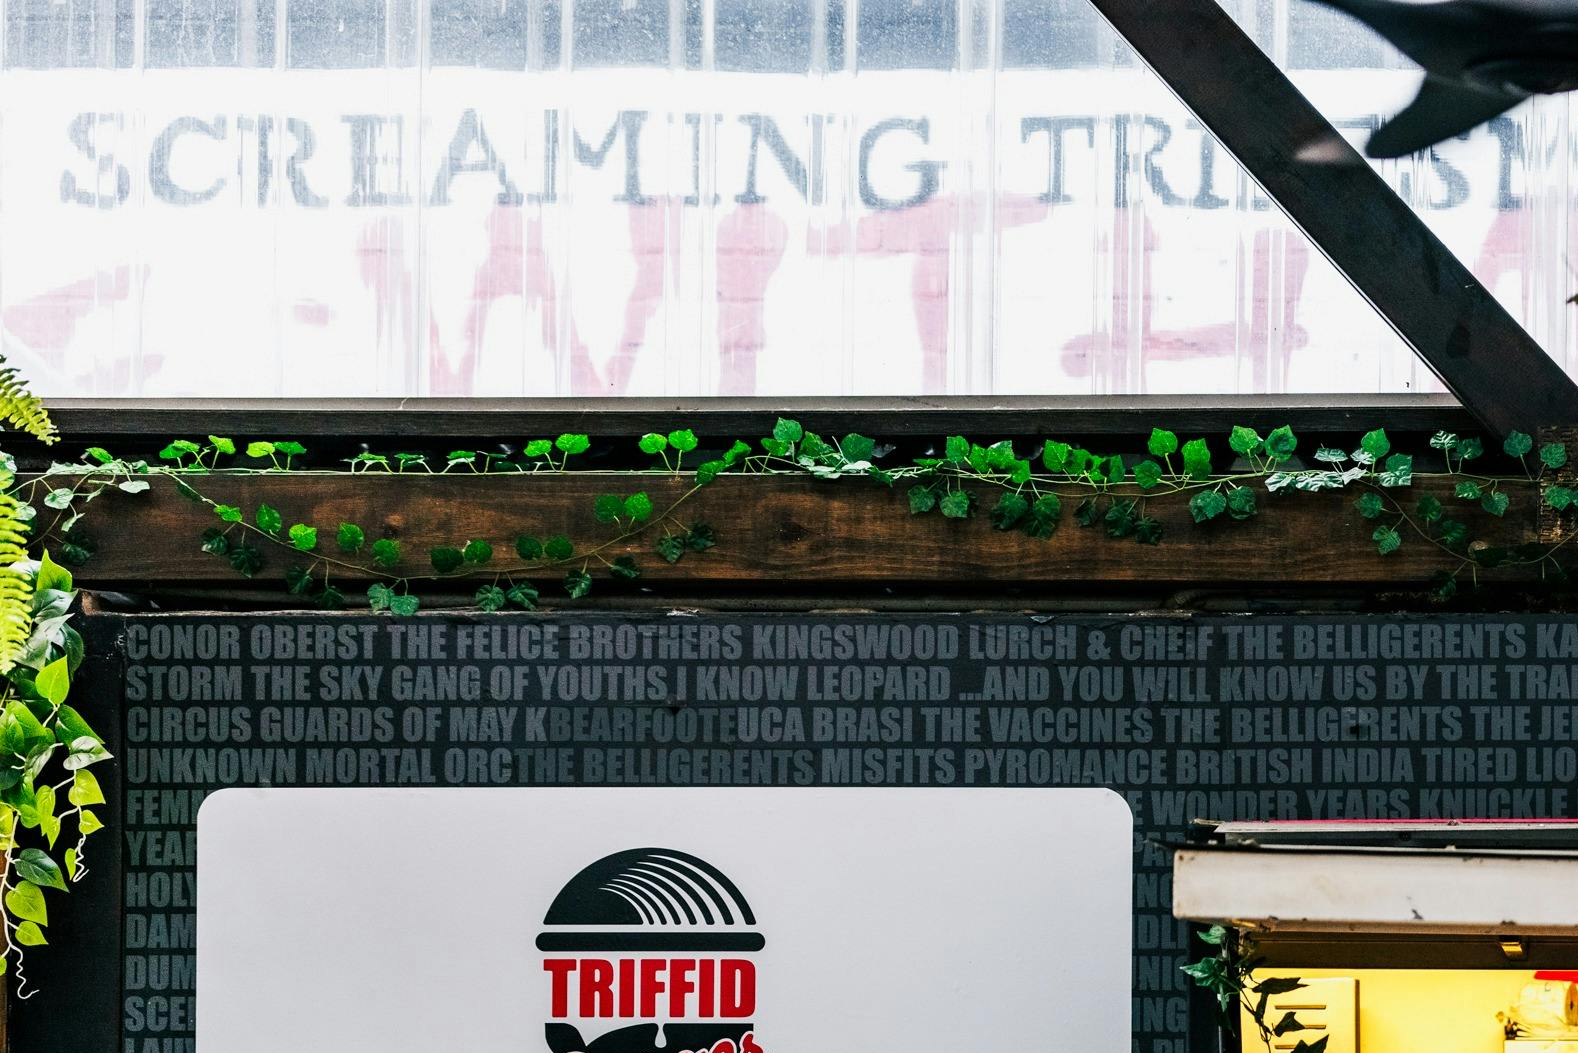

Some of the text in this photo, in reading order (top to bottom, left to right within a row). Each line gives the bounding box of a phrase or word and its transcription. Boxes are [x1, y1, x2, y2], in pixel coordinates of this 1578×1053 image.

[60, 108, 947, 210] SCREAMING
[127, 626, 241, 661] CONOR
[252, 625, 379, 660] OBERST
[388, 626, 447, 660] THE
[458, 626, 560, 660] FELICE
[571, 626, 743, 660] BROTHERS
[754, 625, 959, 660] KINGSWOOD
[971, 624, 1077, 661] LURCH
[1088, 632, 1111, 661] &
[1223, 626, 1284, 660] THE
[1295, 624, 1527, 660] BELLIGERENTS
[127, 666, 668, 701] STORM THE SKY GANG OF YOUTHS
[544, 959, 755, 1017] TRIFFID
